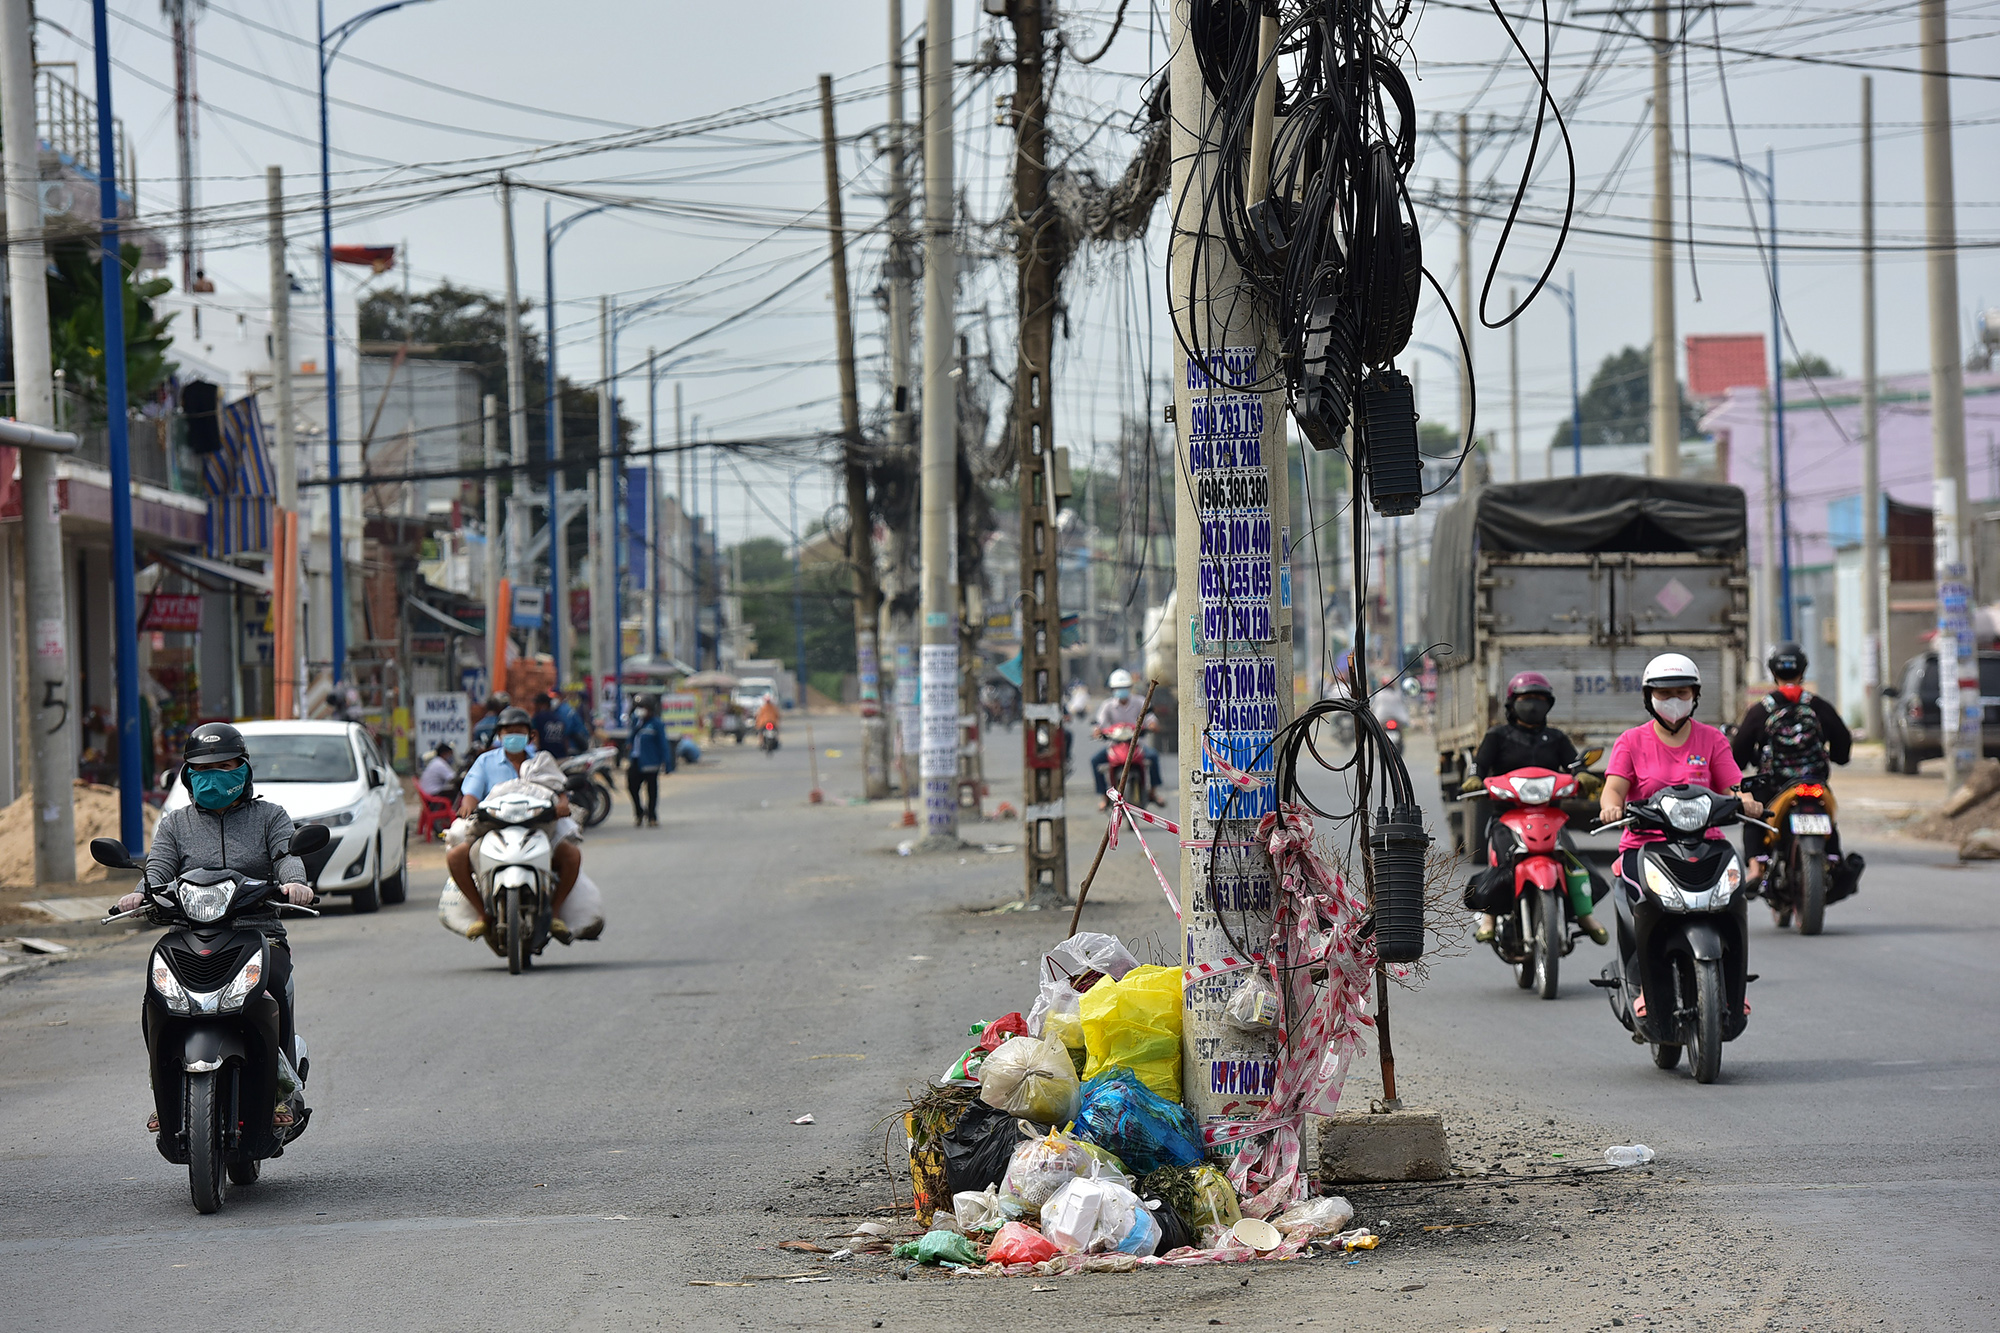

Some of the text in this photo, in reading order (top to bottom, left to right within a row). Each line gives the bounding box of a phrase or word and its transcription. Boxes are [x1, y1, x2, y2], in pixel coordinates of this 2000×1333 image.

[1192, 403, 1263, 434] 0909 293 769
[1240, 440, 1261, 467] 208
[1199, 476, 1268, 510] 0986.380.380
[1200, 520, 1270, 555] 0976.100.400
[1205, 664, 1276, 699] 0976.100.400
[43, 681, 67, 735] 5
